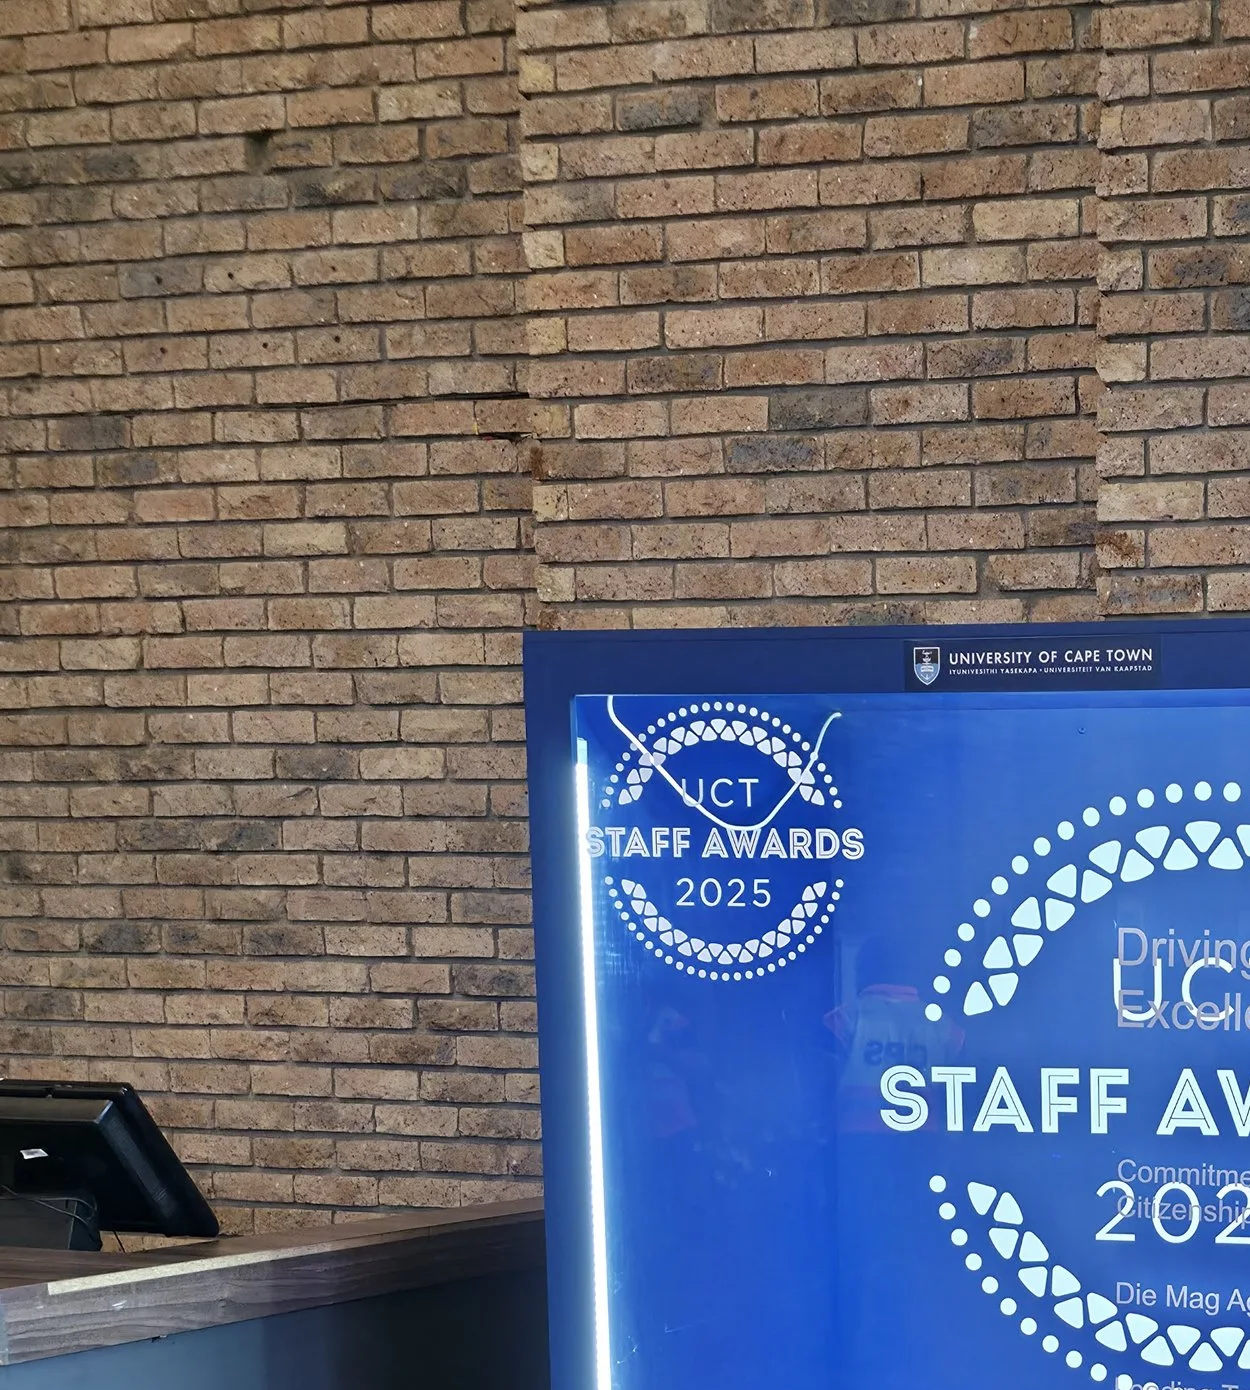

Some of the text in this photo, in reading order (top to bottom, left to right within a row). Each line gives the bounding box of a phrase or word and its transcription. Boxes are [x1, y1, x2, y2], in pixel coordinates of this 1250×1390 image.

[950, 649, 1152, 665] UNIVERSITY OF CAPE TOWN
[681, 778, 759, 807] UCT
[586, 826, 864, 860] STAFF AWARDS
[676, 878, 771, 907] 2025
[879, 1065, 1130, 1135] STAFF
[1116, 1282, 1157, 1306] Die
[1166, 1285, 1220, 1314] Mag
